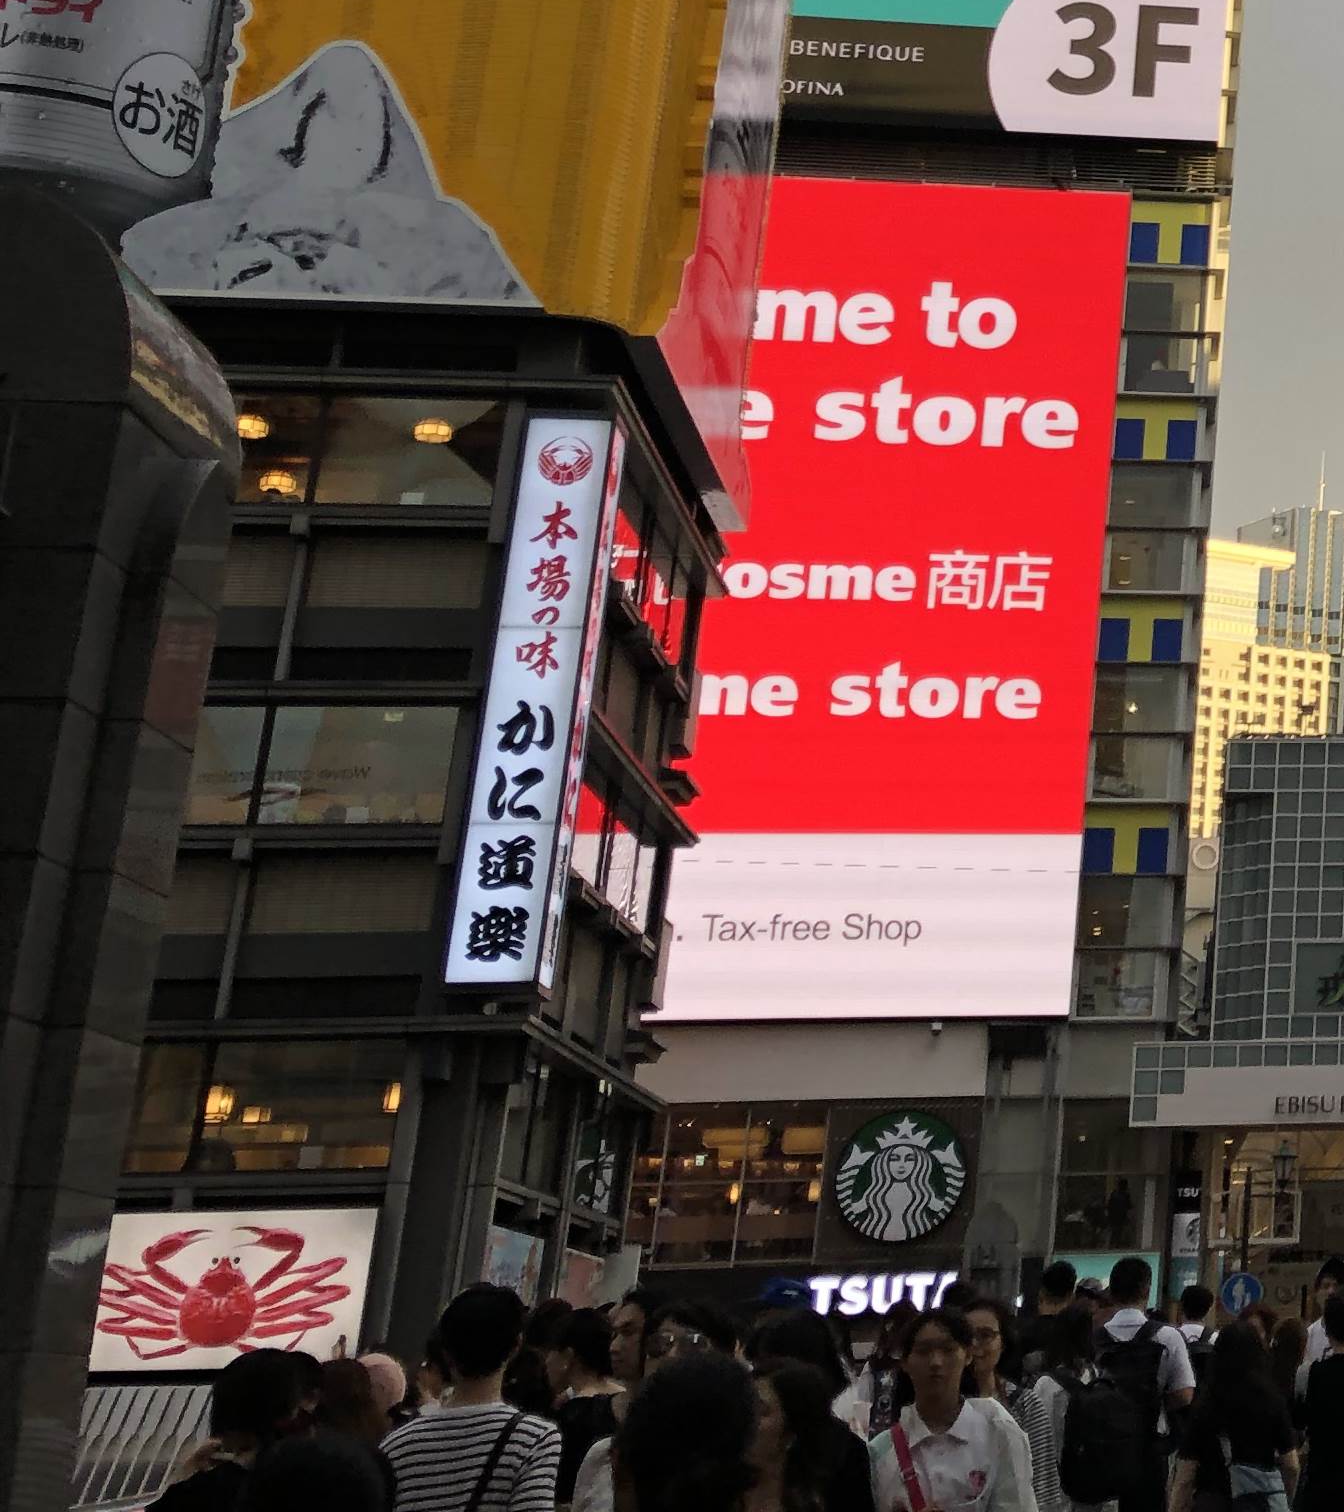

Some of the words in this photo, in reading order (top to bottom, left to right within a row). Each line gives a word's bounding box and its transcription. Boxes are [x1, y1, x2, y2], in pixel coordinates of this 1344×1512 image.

[789, 39, 926, 64] BENEFIQUE
[1045, 0, 1201, 99] 3F
[119, 80, 204, 159] お酒
[920, 280, 1018, 350] to
[812, 374, 1080, 451] store
[514, 499, 580, 681] 本場の味
[720, 561, 917, 601] osme
[926, 548, 1053, 612] 商店
[829, 660, 1042, 720] store
[701, 911, 832, 944] Tax-free
[840, 912, 924, 948] Shop
